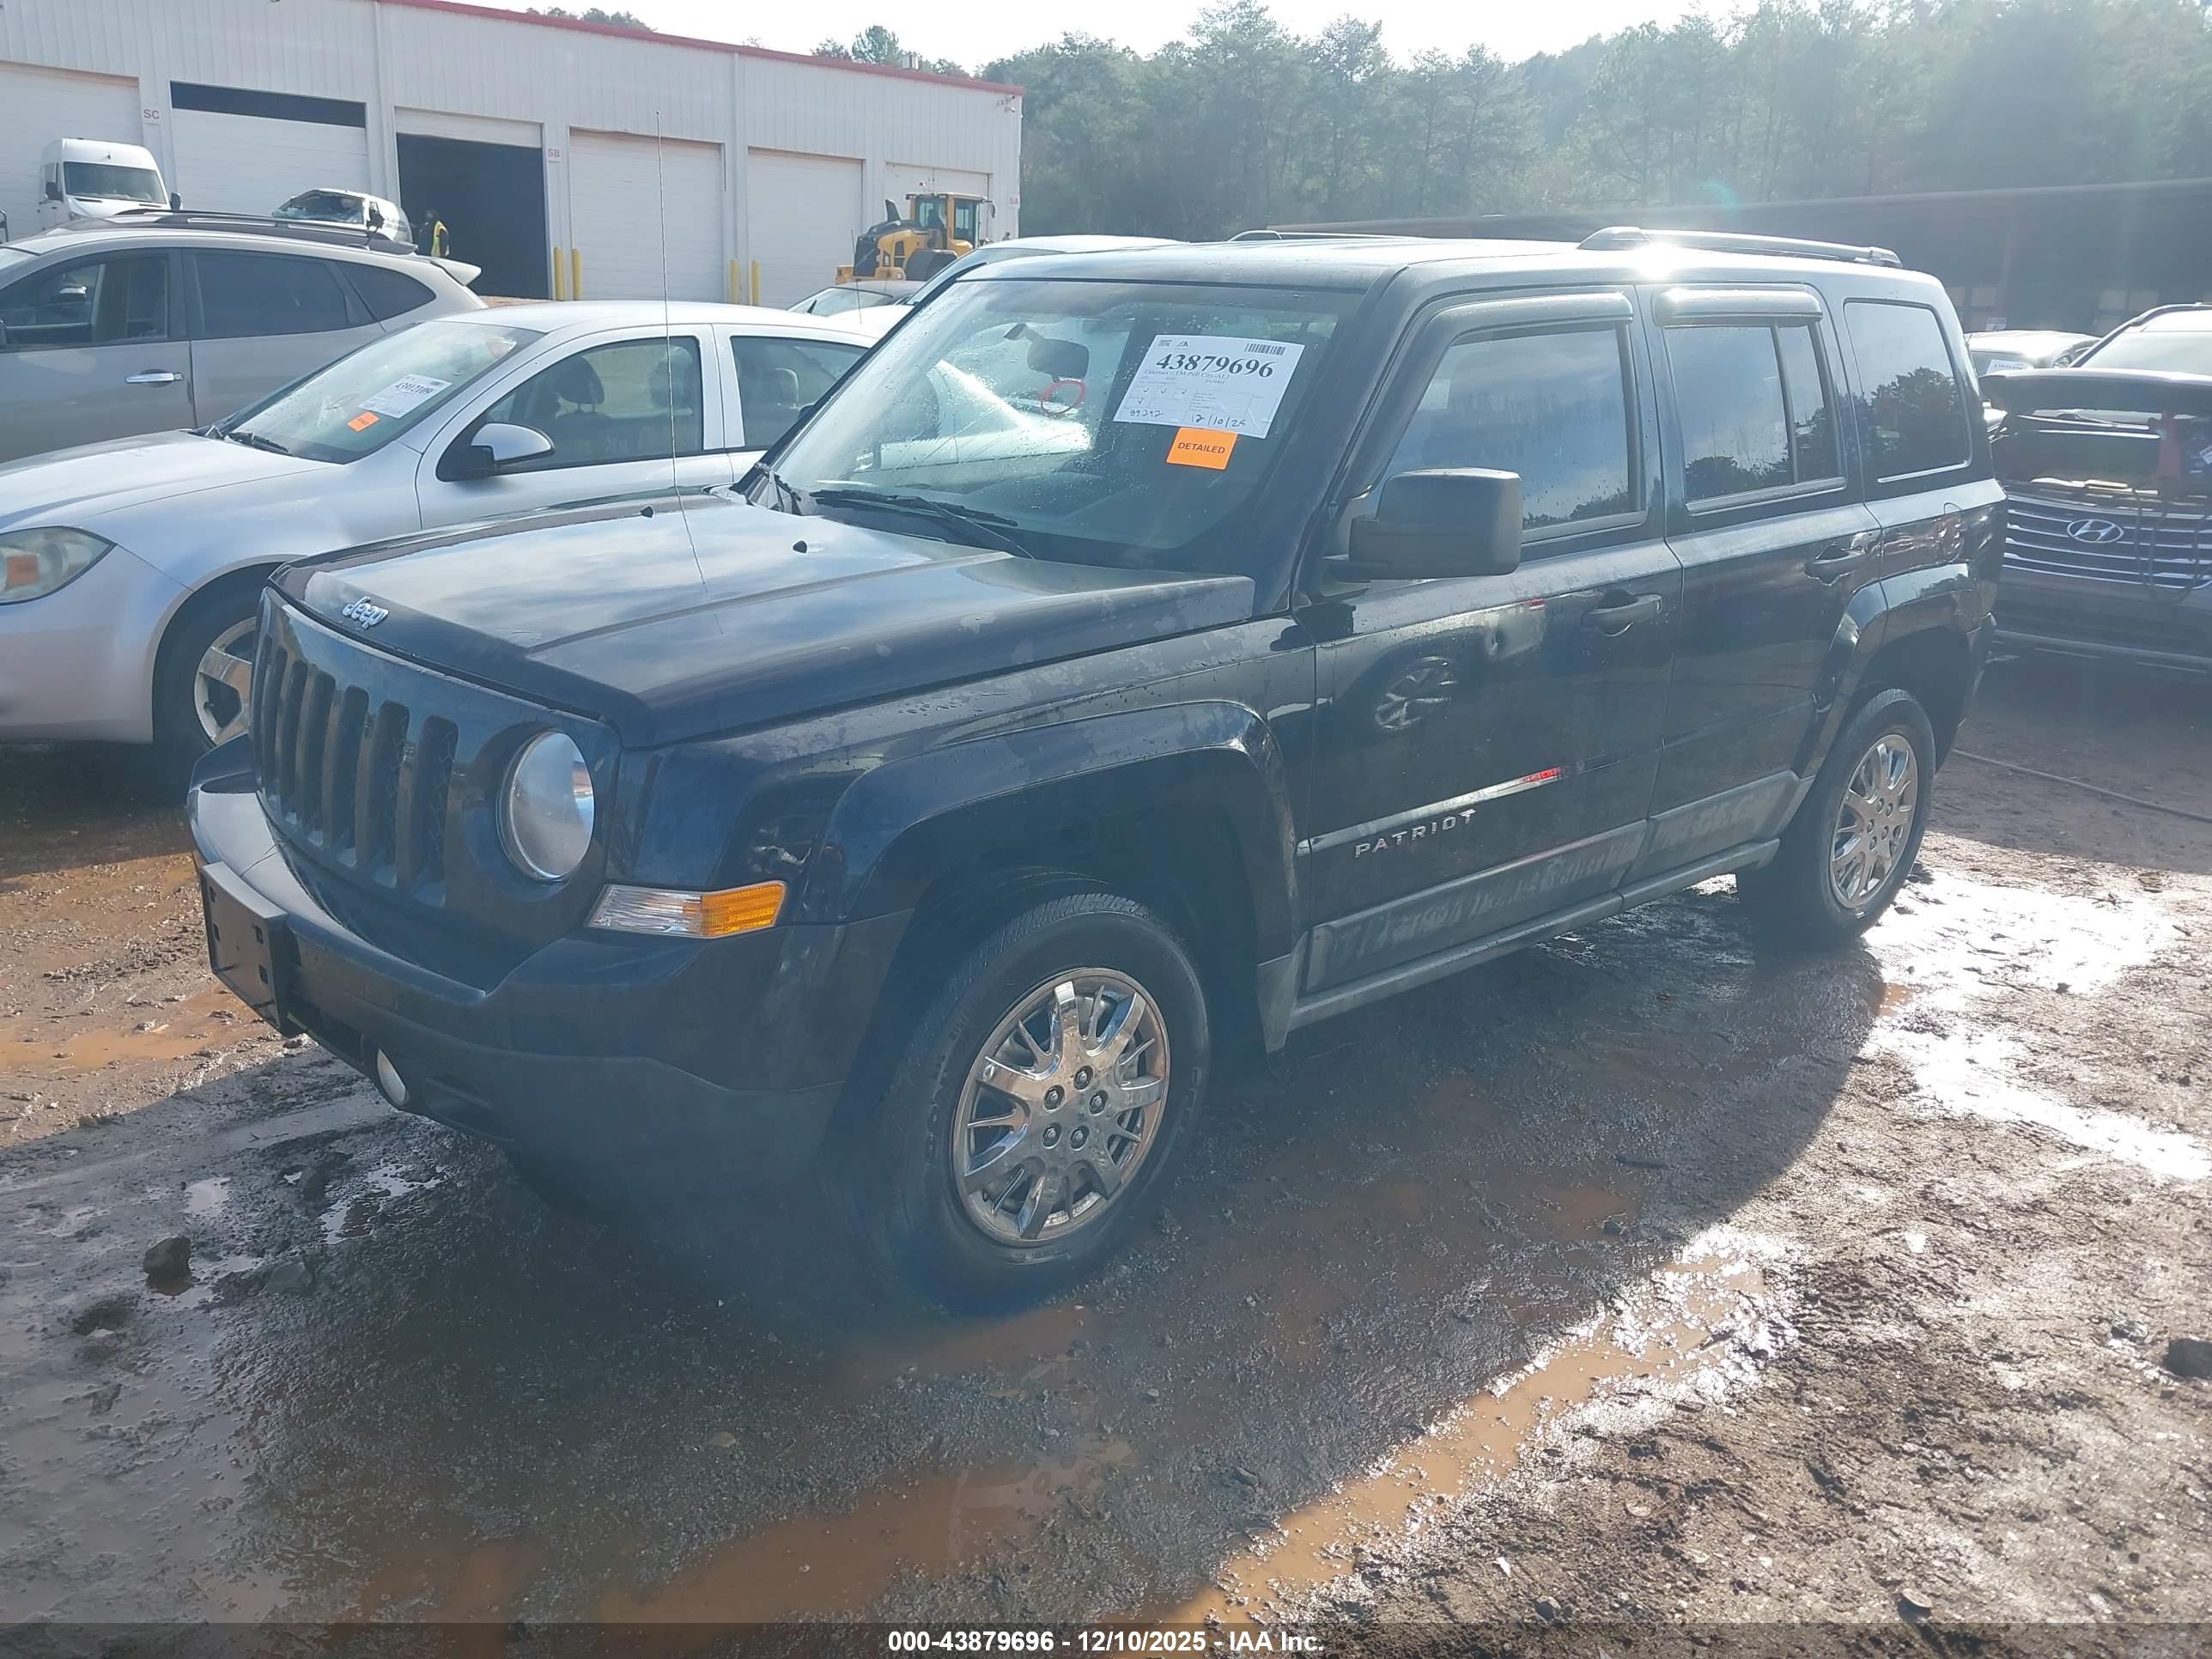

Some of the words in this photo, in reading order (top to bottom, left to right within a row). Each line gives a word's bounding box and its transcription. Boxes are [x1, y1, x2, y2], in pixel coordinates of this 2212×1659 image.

[143, 109, 160, 119] SC
[548, 149, 560, 157] SB
[1156, 353, 1278, 378] 43879696
[1177, 442, 1225, 454] DETAILED
[342, 596, 389, 629] Jeep
[1354, 809, 1476, 859] PATRIOT
